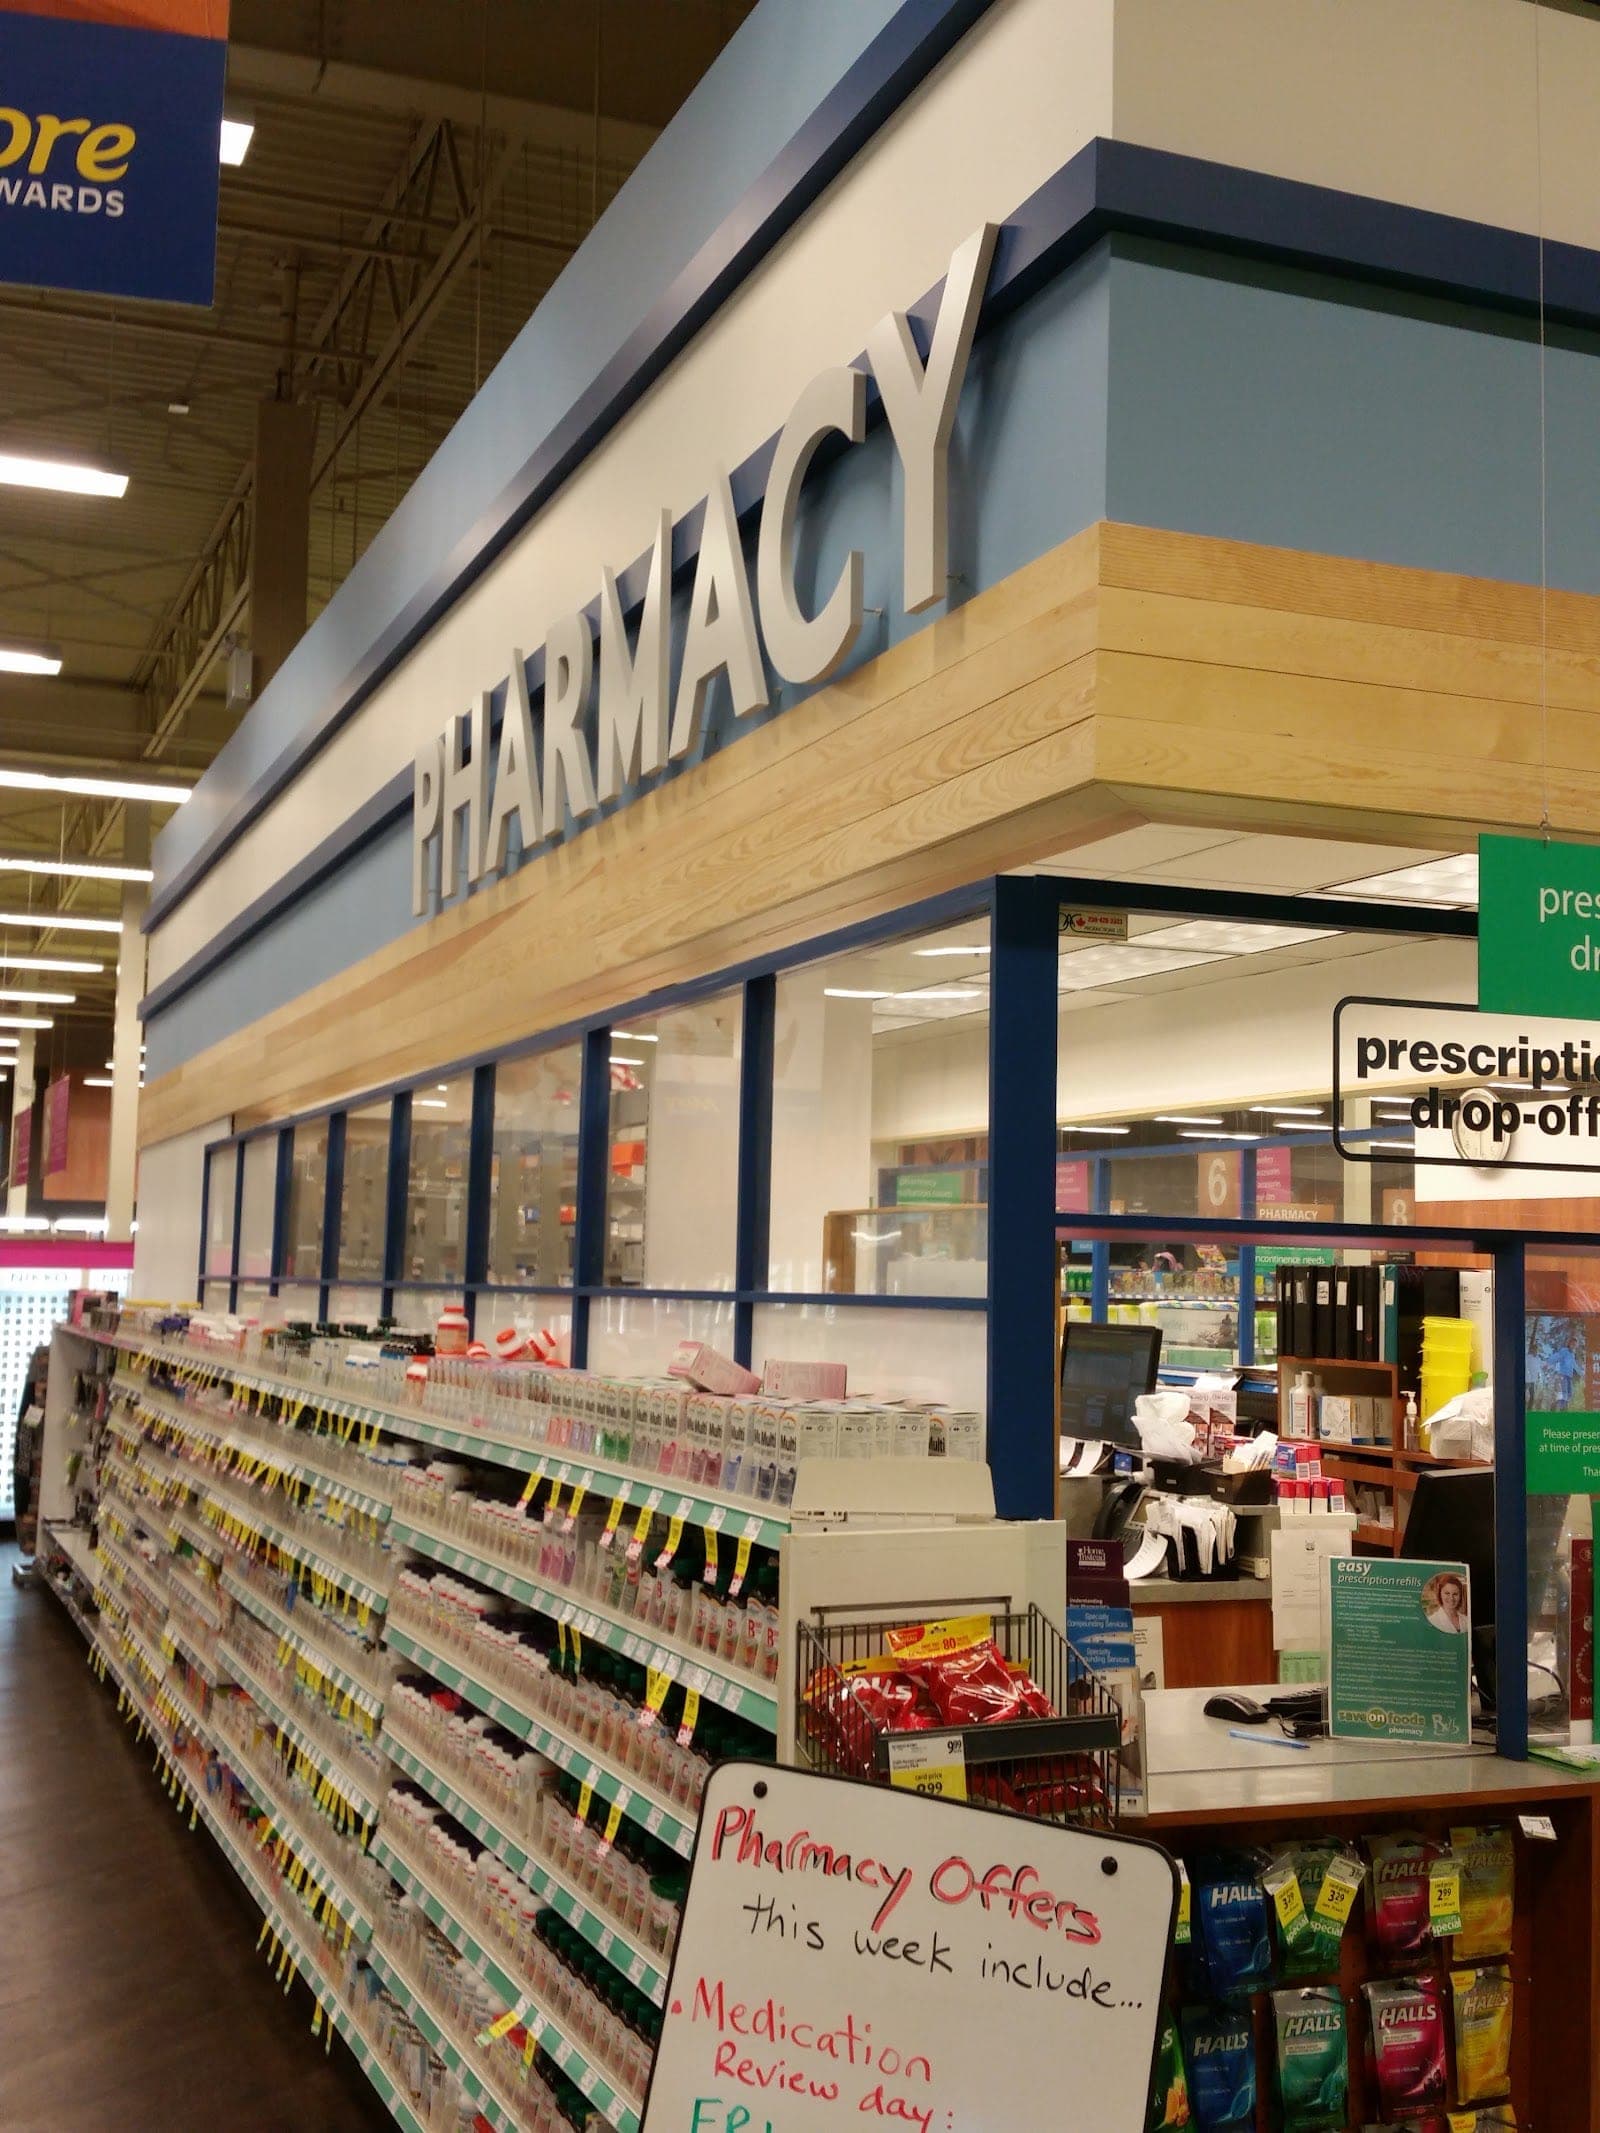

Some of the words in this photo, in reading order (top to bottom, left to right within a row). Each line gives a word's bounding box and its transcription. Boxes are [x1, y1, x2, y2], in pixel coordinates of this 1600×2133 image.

[412, 222, 1003, 917] PHARMACY
[1410, 1087, 1600, 1142] drop-off
[1207, 1158, 1227, 1206] 6
[1259, 1208, 1319, 1221] PHARMACY
[1303, 1256, 1326, 1264] needs
[780, 1434, 797, 1452] Multi
[1543, 1428, 1571, 1439] Please
[1539, 1444, 1548, 1452] at
[1550, 1443, 1570, 1453] time
[1572, 1443, 1582, 1453] of
[1337, 1562, 1372, 1576] easy
[1337, 1574, 1394, 1586] prescription
[1395, 1578, 1421, 1587] refills
[942, 1637, 957, 1649] 80
[1388, 1727, 1424, 1736] pharmacy
[711, 1805, 913, 1933] Pharmacy
[930, 1856, 1101, 1946] Offers
[1379, 1861, 1431, 1884] HALL
[1211, 1885, 1265, 1908] HALLS
[1310, 1920, 1344, 1937] special
[1432, 1919, 1462, 1937] special
[743, 1894, 825, 1951] this
[854, 1929, 953, 1973] week
[981, 1943, 1143, 2009] include...
[1284, 2014, 1342, 2038] HALLS
[1379, 2004, 1437, 2030] HALLS
[692, 1977, 931, 2082] Medication
[1193, 2031, 1249, 2058] HALLS
[714, 2040, 839, 2100] Review
